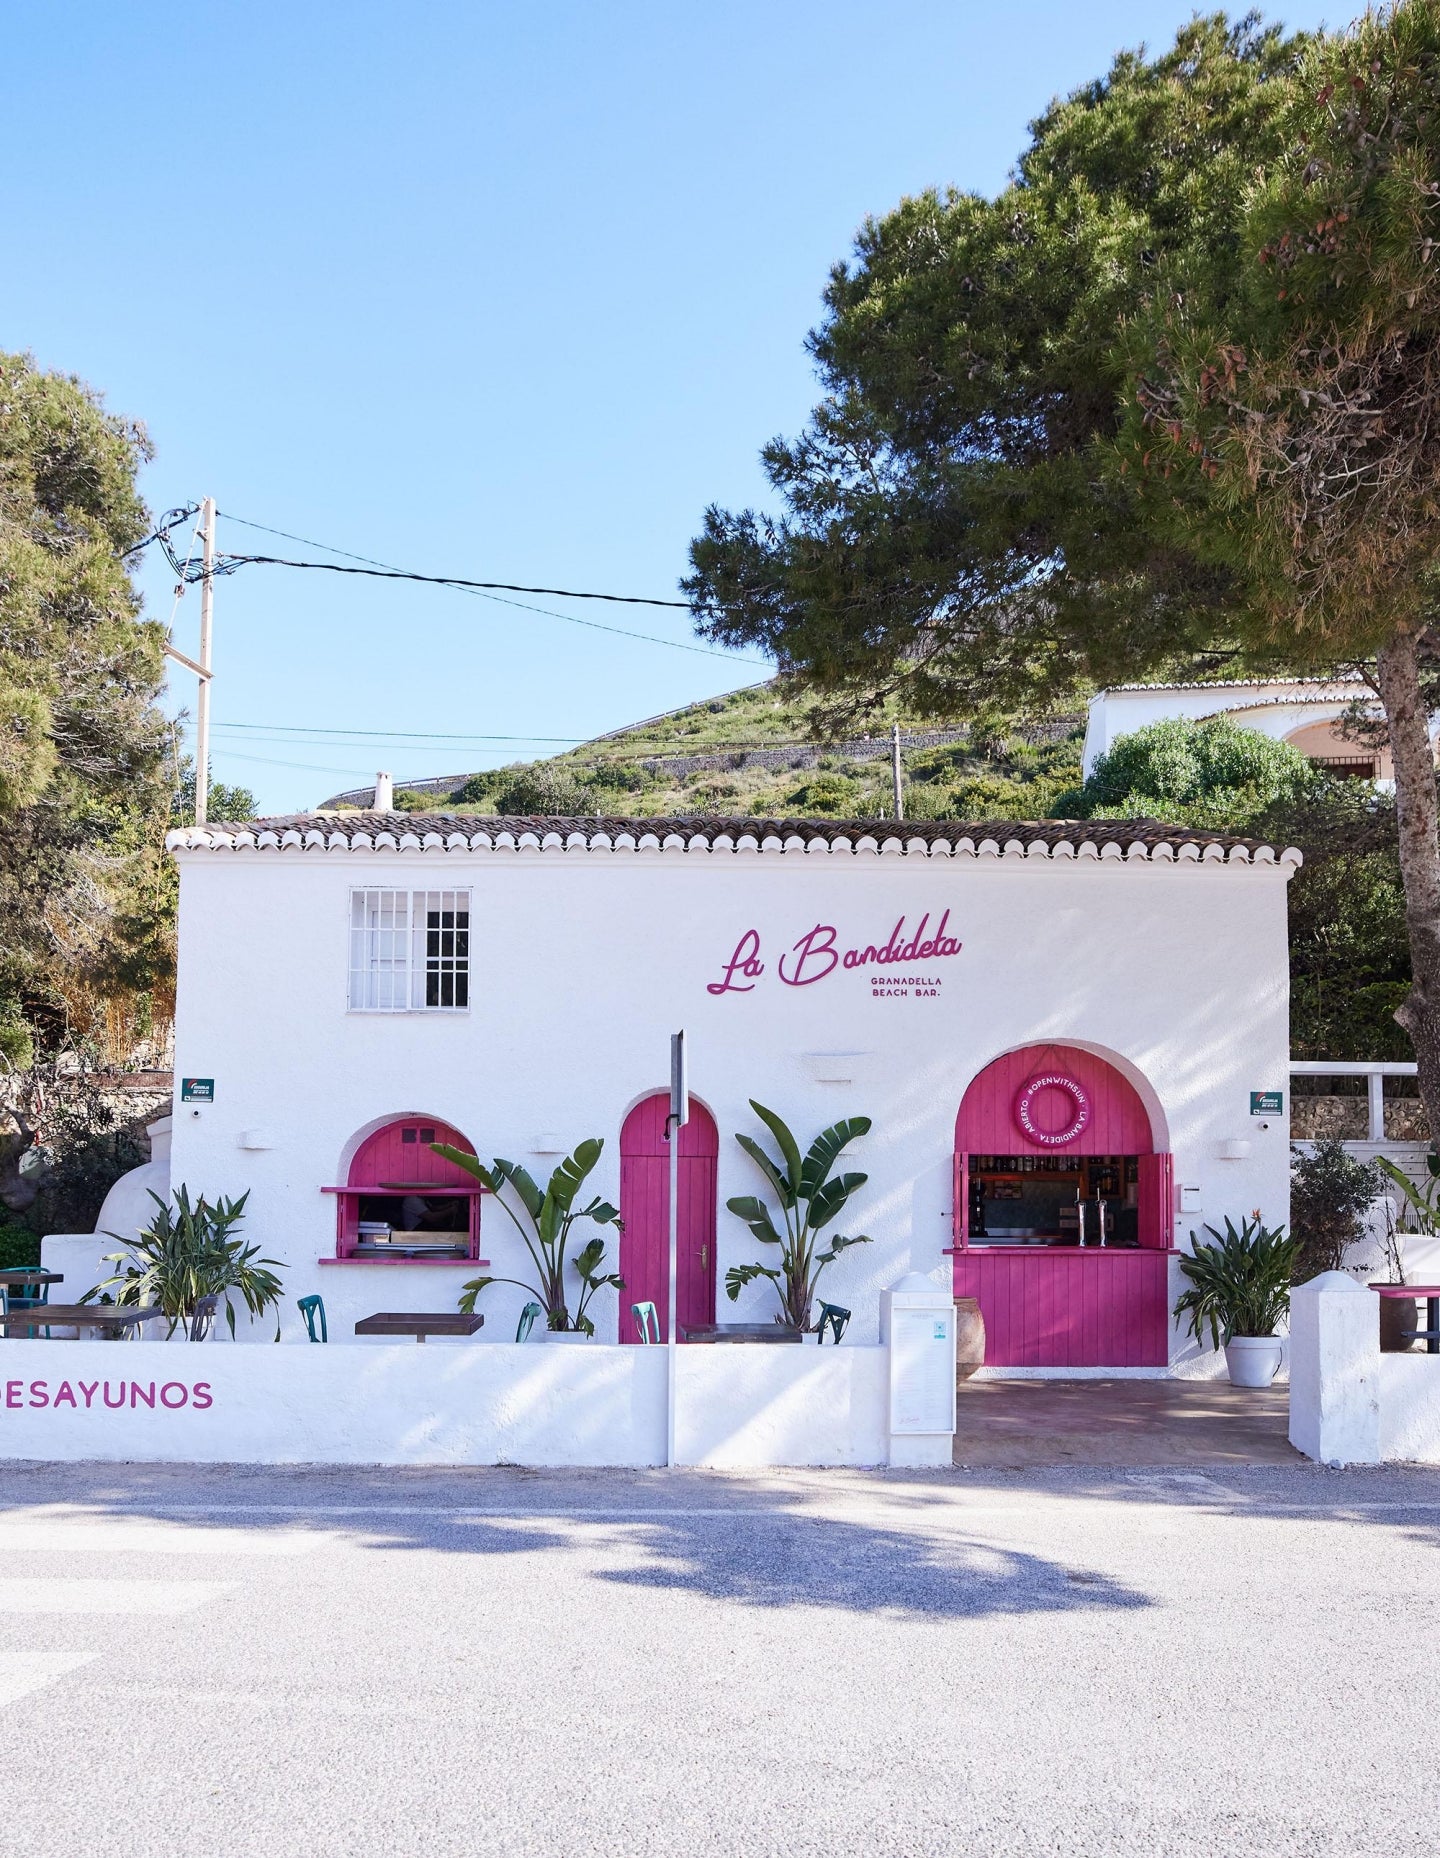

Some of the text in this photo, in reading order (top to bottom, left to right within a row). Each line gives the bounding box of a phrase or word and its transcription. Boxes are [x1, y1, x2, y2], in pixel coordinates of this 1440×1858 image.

[707, 908, 962, 995] La Bandideta
[871, 977, 942, 986] GRANADELLA
[872, 988, 941, 997] BEACH BAR.
[1020, 1100, 1036, 1133] ABIERTO
[1079, 1111, 1087, 1122] LA
[1040, 1123, 1083, 1144] BANDIDETA
[0, 1380, 214, 1409] ESAYUNOS
